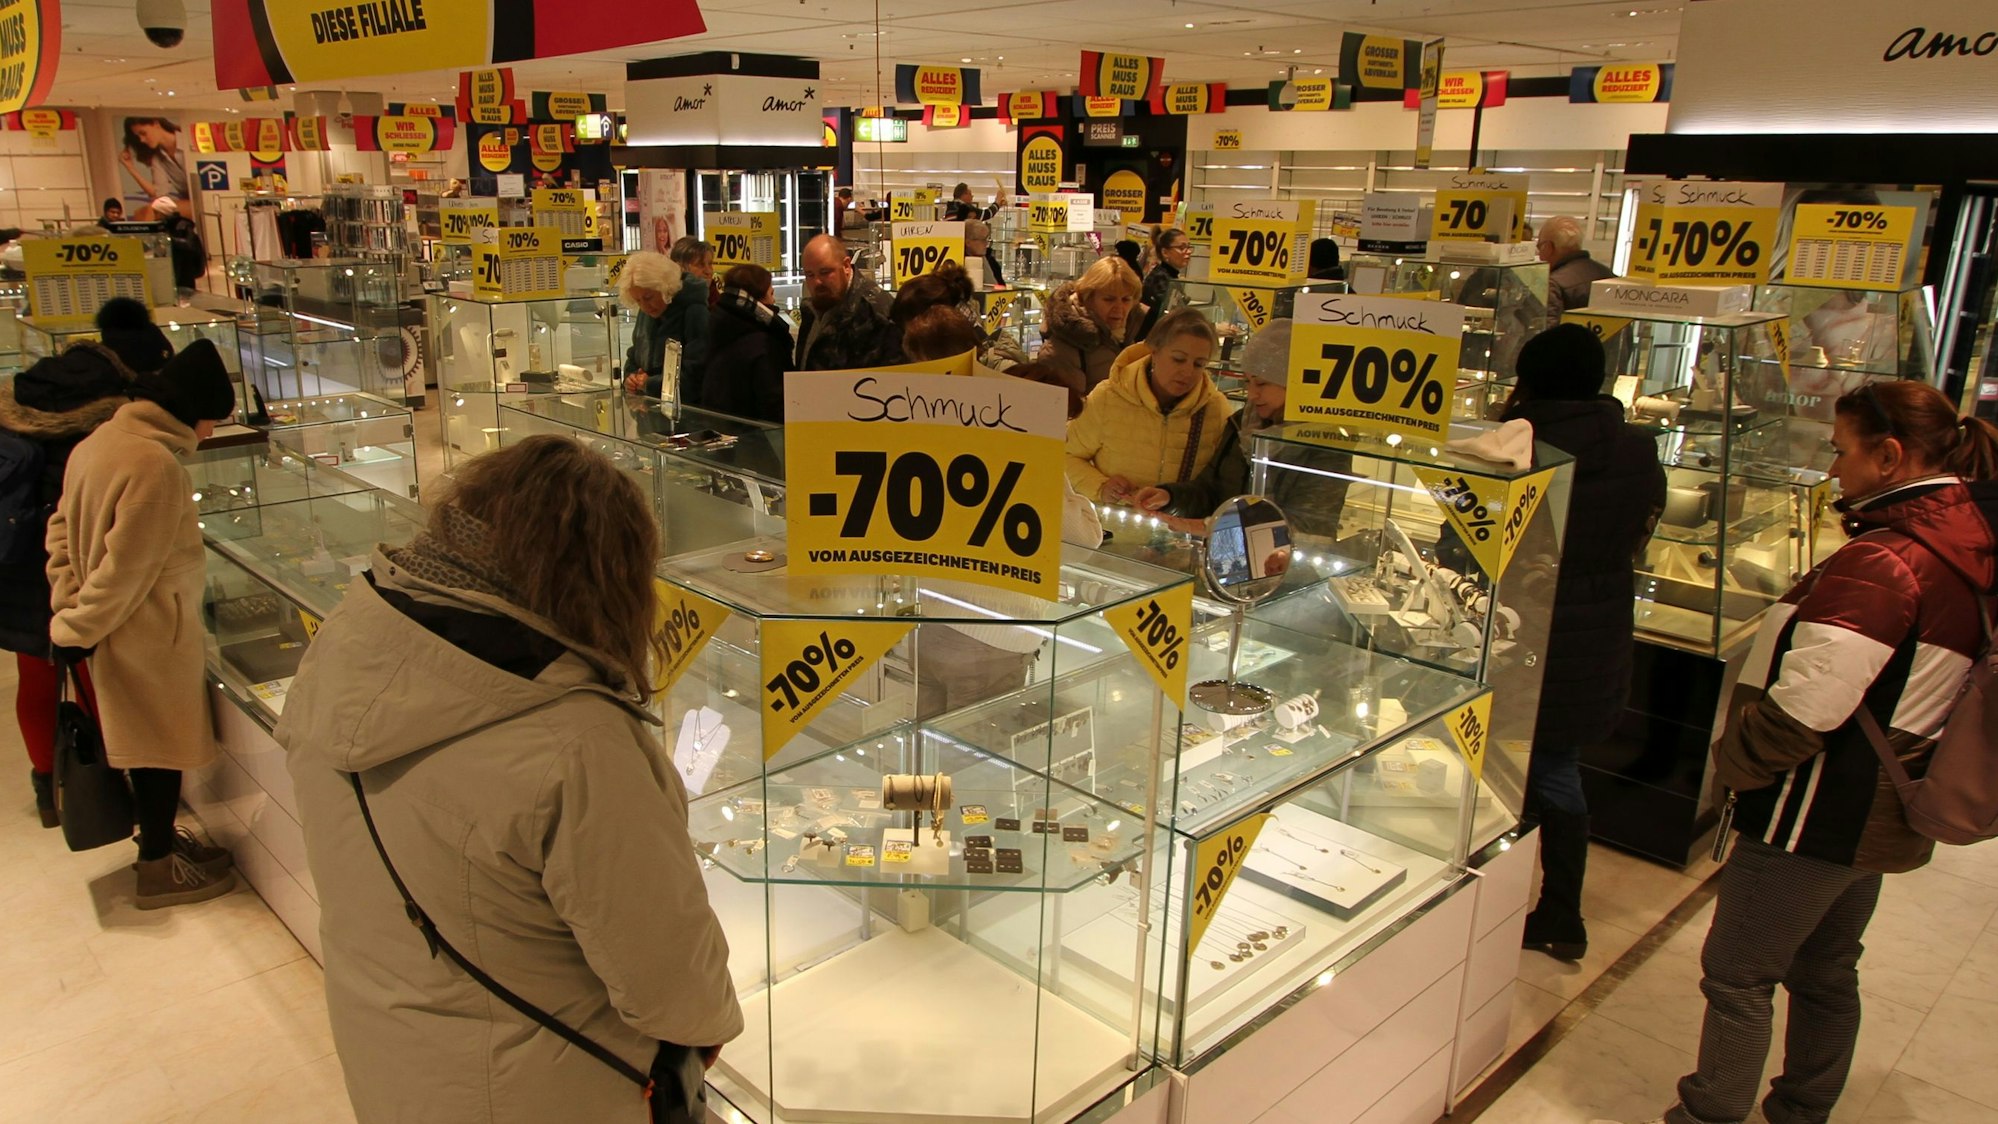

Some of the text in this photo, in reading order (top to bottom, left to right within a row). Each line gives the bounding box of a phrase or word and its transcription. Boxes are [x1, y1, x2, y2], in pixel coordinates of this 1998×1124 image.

[311, 0, 426, 44] DIESE FILIALE
[1, 12, 26, 59] MUSS
[1365, 46, 1398, 59] GROSSER
[1883, 27, 1998, 62] amo
[1114, 58, 1138, 70] ALLES
[922, 72, 956, 85] ALLES
[1112, 70, 1138, 82] MUSS
[1364, 68, 1398, 78] ABVERKAUF
[1604, 70, 1651, 83] ALLES
[921, 86, 957, 95] REDUZIERT
[1110, 84, 1136, 96] RAUS
[1176, 86, 1198, 94] ALLES
[1296, 84, 1326, 92] ROSSER
[1444, 78, 1464, 86] WIR
[1602, 84, 1650, 92] REDUZIERT
[1438, 88, 1474, 96] CHLIESSEN
[409, 107, 436, 115] ALLES
[1176, 104, 1197, 112] RAUS
[396, 122, 415, 131] WIR
[1091, 123, 1116, 133] PREIS
[1216, 136, 1238, 146] -70%
[1028, 150, 1056, 160] ALLES
[1028, 162, 1056, 174] MUSS
[208, 171, 222, 189] P
[1027, 175, 1056, 186] RAUS
[549, 193, 575, 204] -70%
[1105, 190, 1143, 198] GROSSER
[1678, 184, 1754, 206] Schmuck
[1232, 203, 1284, 220] Schmuck
[1826, 211, 1888, 230] -70%
[508, 232, 539, 248] -70%
[1663, 220, 1760, 267] -70%
[56, 244, 118, 262] -70%
[1219, 230, 1288, 270] -70%
[898, 246, 955, 278] -70%
[1614, 288, 1689, 304] MONCARA
[988, 294, 1006, 323] -70%
[1242, 290, 1267, 325] -70%
[1318, 299, 1436, 334] Schmuck
[1302, 344, 1443, 414] -70%
[848, 377, 1028, 432] Schmuck
[1299, 406, 1440, 432] VOM AUSGEZEICHNETEN PREIS
[809, 451, 1042, 557] -70%
[1444, 477, 1496, 542] -70%
[1504, 483, 1536, 546] -70%
[809, 550, 1042, 584] VOM AUSGEZEICHNETEN PREIS
[656, 599, 700, 666] 70%
[1136, 600, 1184, 670] -70%
[766, 631, 856, 712] -70%
[790, 655, 864, 724] VOM AUSGEZEICHNETEN PREIS
[1460, 706, 1484, 755] -70%
[1195, 836, 1244, 916] -70%
